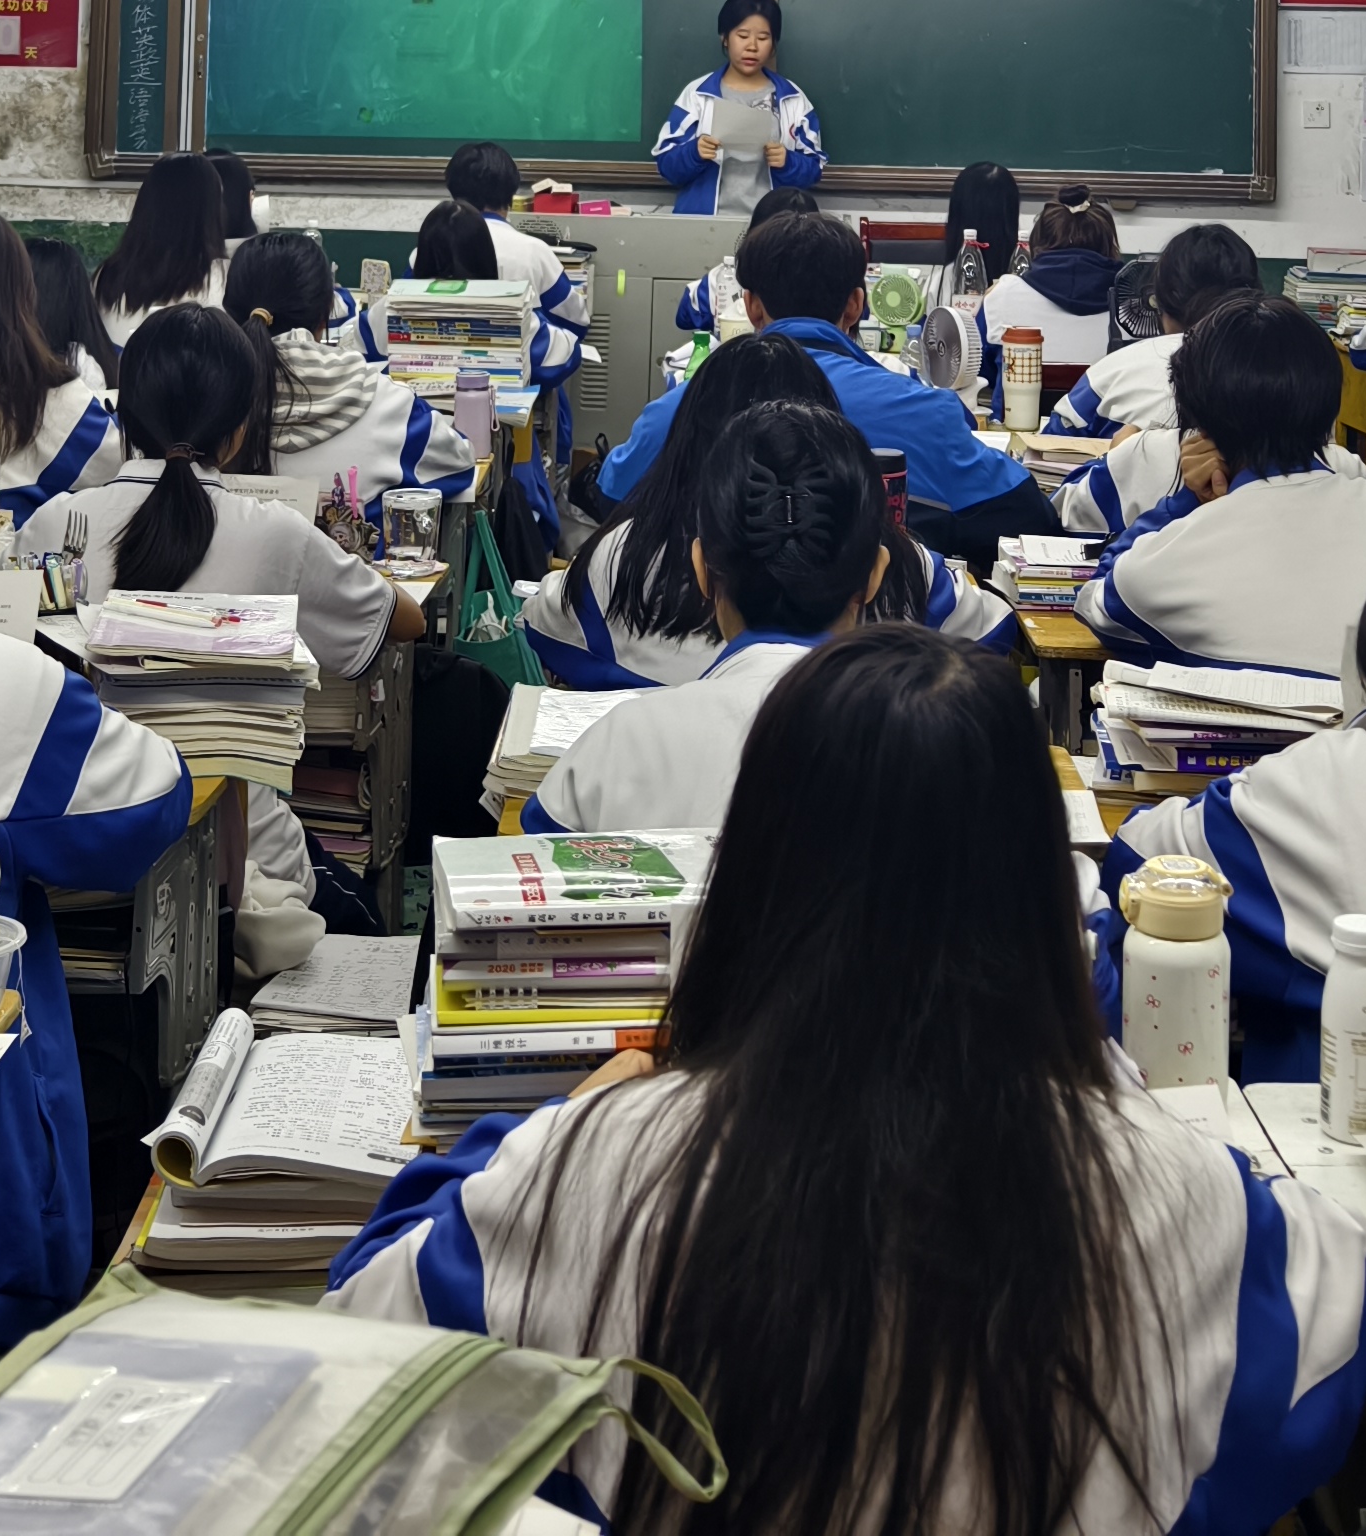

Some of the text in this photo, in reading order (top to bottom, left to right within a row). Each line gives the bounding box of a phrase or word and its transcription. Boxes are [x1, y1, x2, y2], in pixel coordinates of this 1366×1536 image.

[24, 46, 38, 60] 天
[480, 1038, 528, 1050] 三维设计
